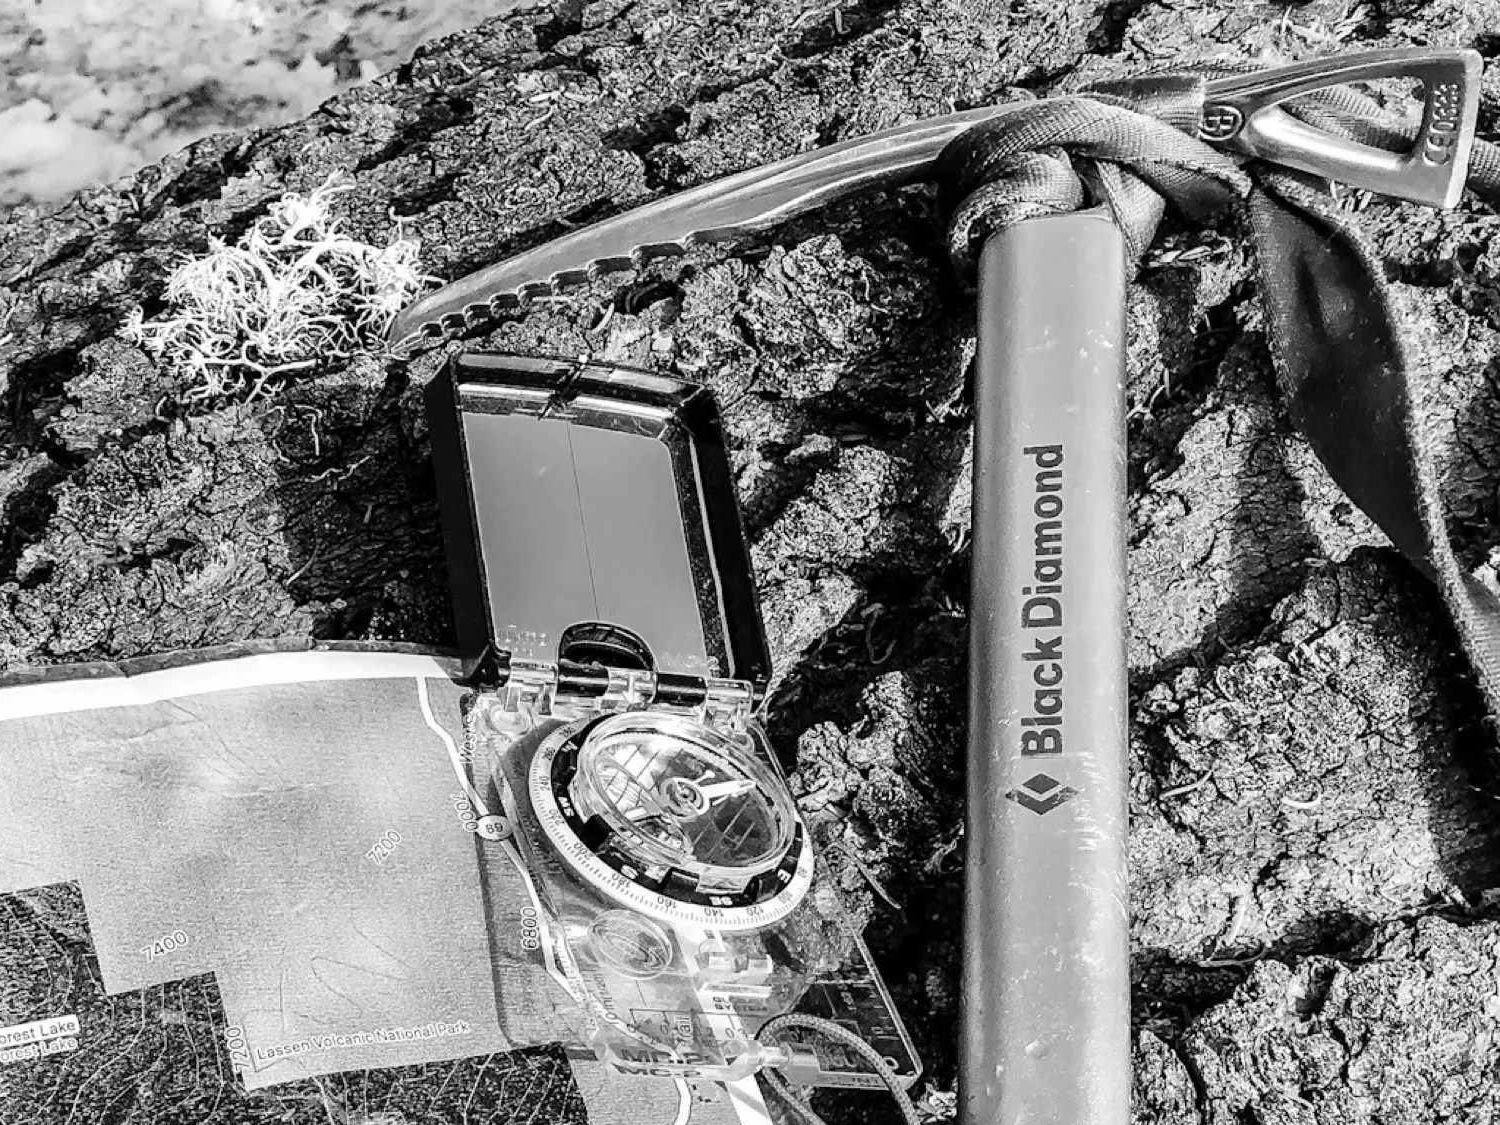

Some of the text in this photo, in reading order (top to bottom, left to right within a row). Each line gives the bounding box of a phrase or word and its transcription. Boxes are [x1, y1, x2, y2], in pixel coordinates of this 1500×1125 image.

[1020, 444, 1064, 757] Black Diamond
[365, 830, 401, 866] 7200
[657, 895, 678, 910] 160
[703, 906, 725, 919] 140
[521, 906, 538, 951] 6800
[142, 930, 188, 962] 7400
[39, 1020, 77, 1038] Lake
[257, 1020, 471, 1061] Lassen Volcanic National Park
[41, 1037, 78, 1056] Lake
[228, 1025, 249, 1071] 7200
